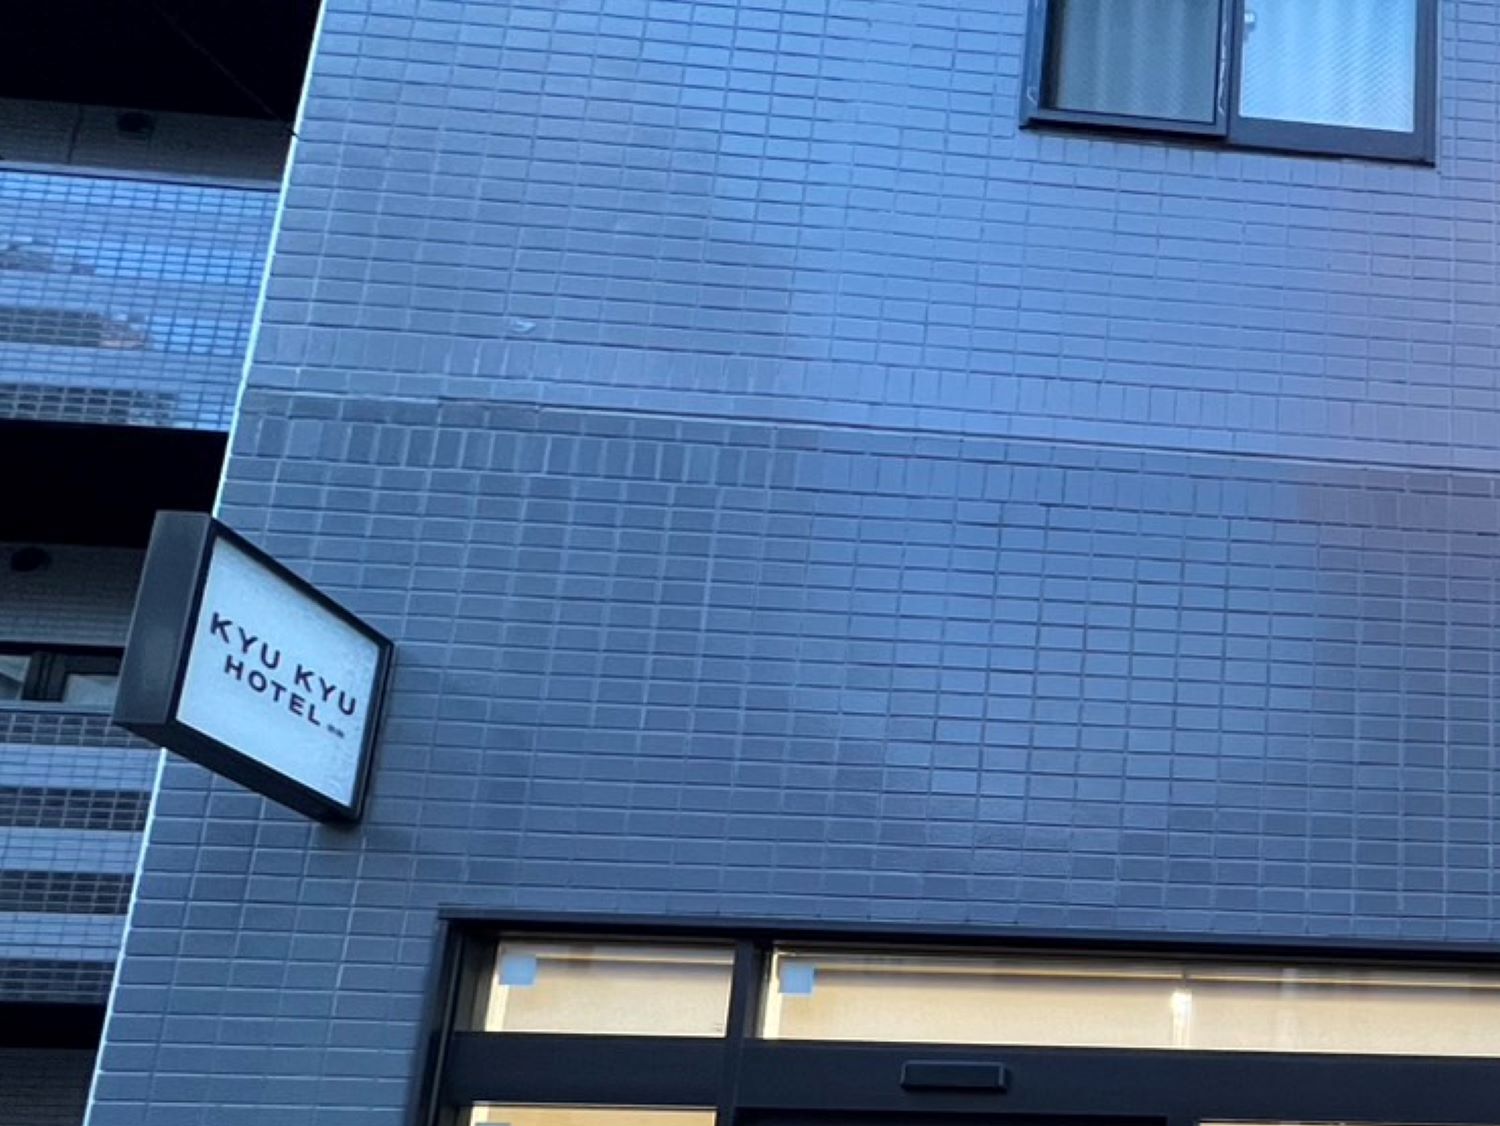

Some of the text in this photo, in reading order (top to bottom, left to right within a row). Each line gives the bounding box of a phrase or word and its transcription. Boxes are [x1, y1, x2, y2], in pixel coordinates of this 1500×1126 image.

[210, 612, 356, 715] KYU KYU
[224, 655, 320, 726] HOTEL
